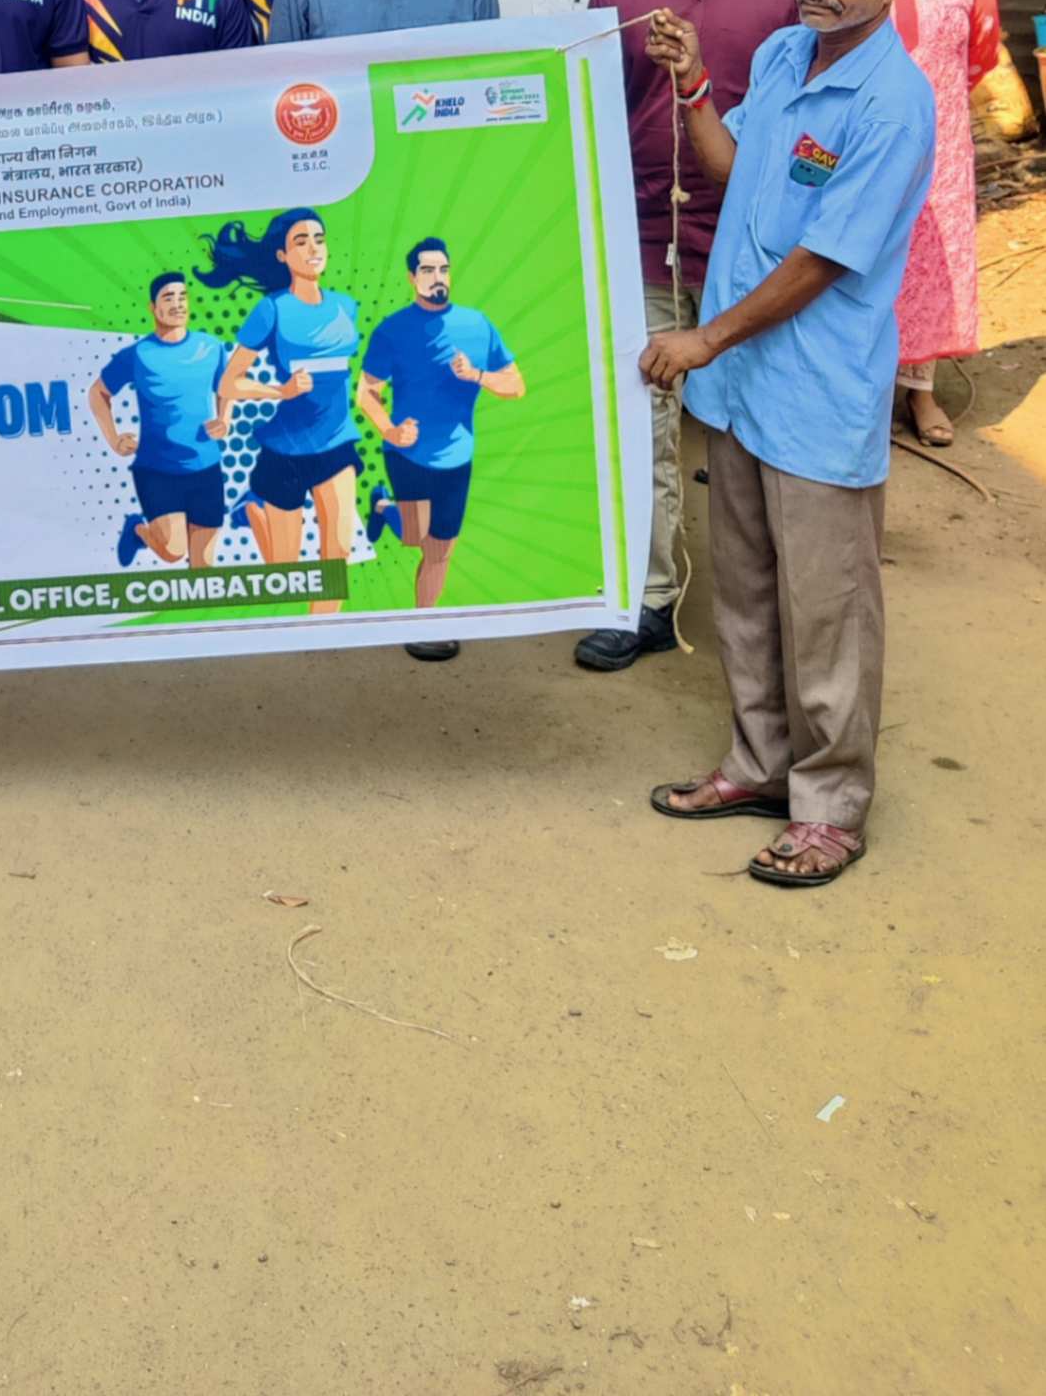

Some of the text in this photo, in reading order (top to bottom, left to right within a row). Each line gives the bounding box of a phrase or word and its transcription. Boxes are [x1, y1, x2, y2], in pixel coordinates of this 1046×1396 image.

[175, 6, 217, 28] INDIA
[26, 145, 56, 163] बीमा
[58, 142, 98, 160] निगम
[58, 162, 91, 178] भारत
[94, 157, 143, 177] सरकार)
[101, 174, 225, 197] CORPORATION
[19, 203, 102, 221] Employment,
[105, 198, 137, 213] Govt
[139, 196, 153, 210] of
[156, 194, 191, 210] India)
[10, 582, 119, 611] OFFICE,
[125, 570, 323, 603] COIMBATORE
